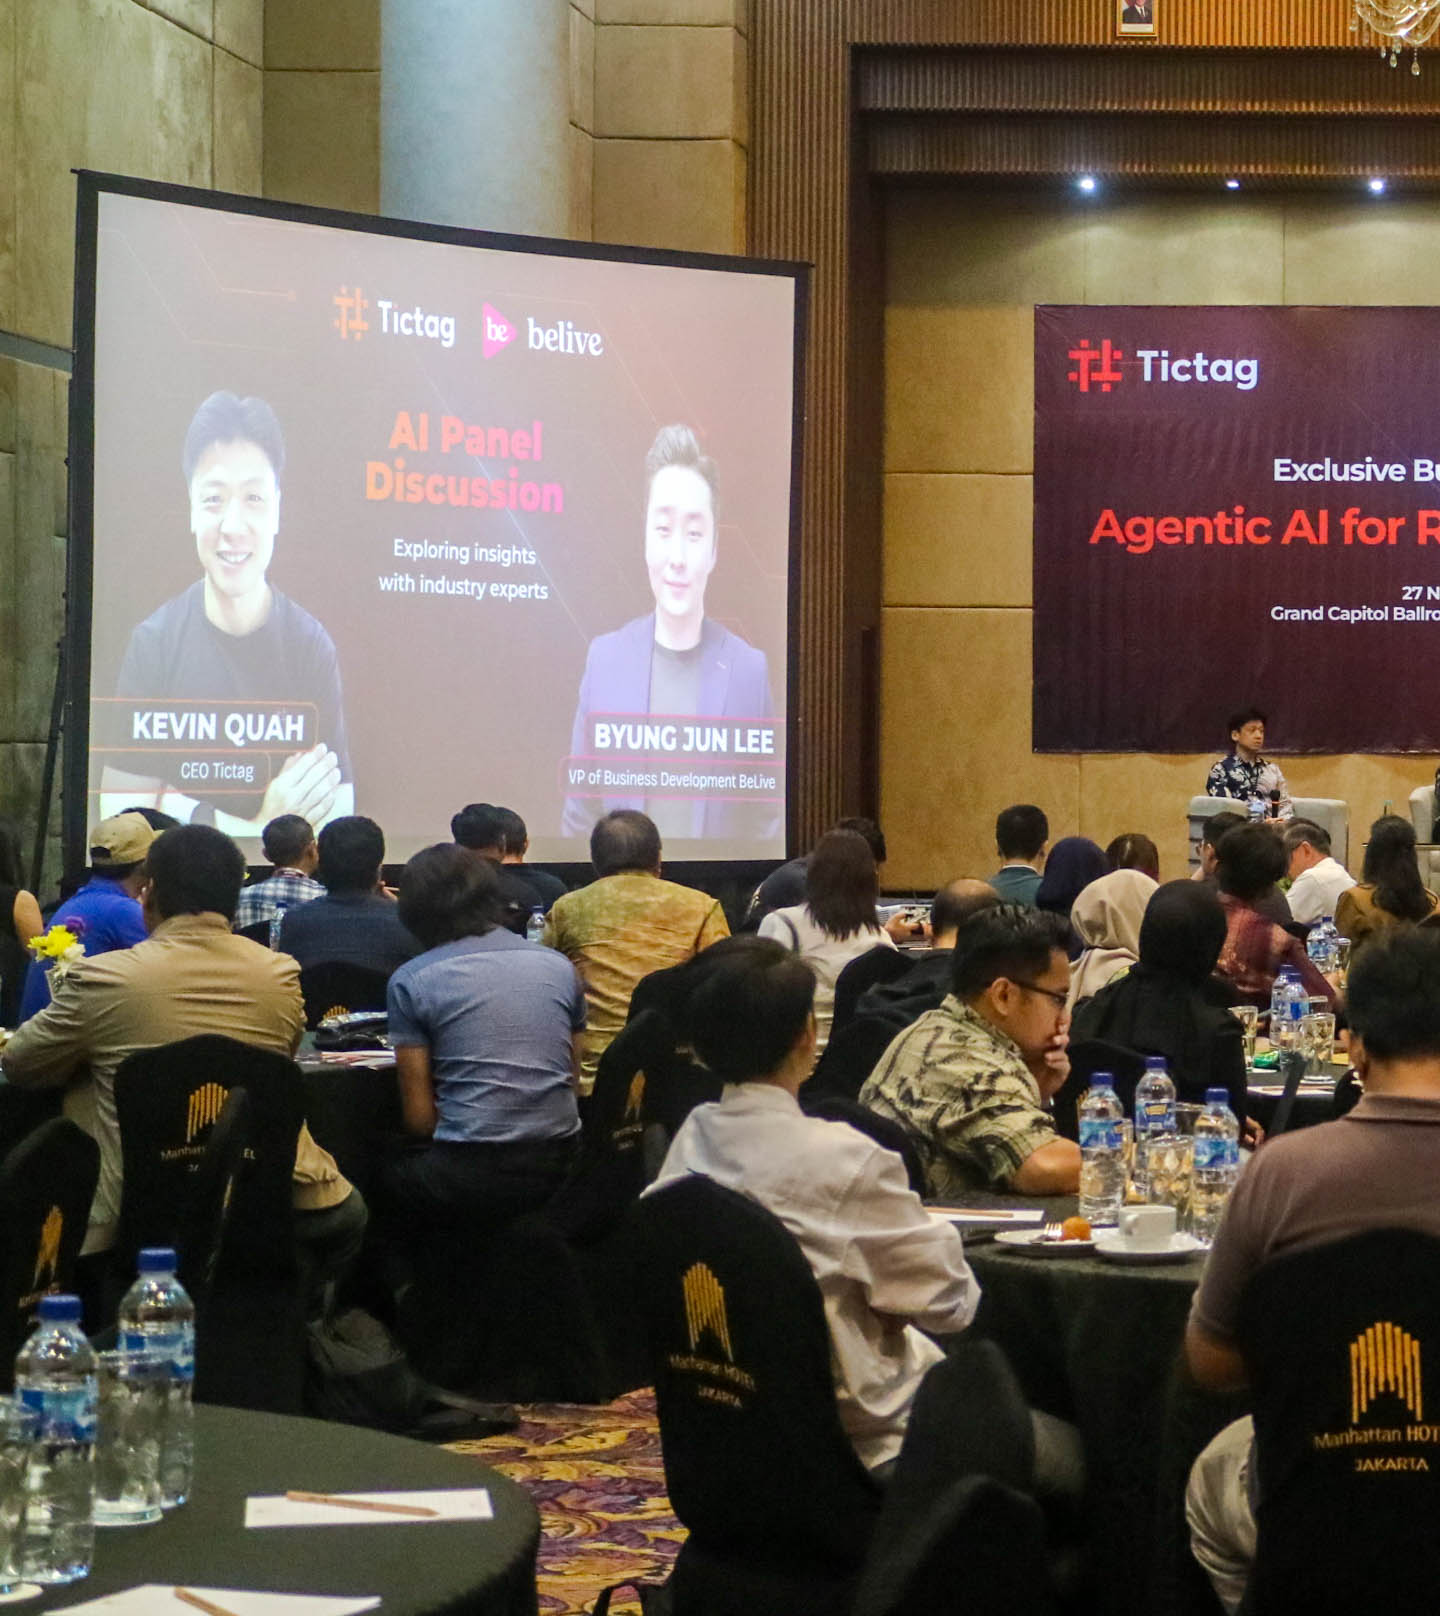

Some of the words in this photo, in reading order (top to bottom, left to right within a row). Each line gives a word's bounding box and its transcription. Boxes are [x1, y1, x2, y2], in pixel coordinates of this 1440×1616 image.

[378, 300, 456, 348] Tictag
[486, 316, 509, 342] be
[527, 317, 603, 356] belive
[1136, 350, 1258, 390] Tictag
[388, 411, 429, 451] AI
[441, 416, 543, 461] Panel
[366, 456, 563, 513] Discussion
[1273, 457, 1406, 482] Exclusive
[1089, 505, 1272, 554] Agentic
[1281, 509, 1327, 545] AI
[1340, 507, 1405, 545] for
[393, 538, 469, 564] Exploring
[474, 543, 536, 567] insights
[378, 572, 415, 592] with
[419, 574, 486, 600] industry
[490, 579, 548, 602] experts
[1402, 586, 1423, 600] 27
[1271, 605, 1323, 621] Grand
[1328, 605, 1388, 624] Capitol
[133, 711, 217, 740] KEVIN
[224, 712, 304, 747] QUAH
[595, 723, 677, 751] BYUNG
[683, 726, 728, 752] JUN
[734, 729, 774, 754] LEE
[181, 762, 209, 779] CEO
[213, 762, 254, 783] Tictag
[568, 769, 585, 784] VP
[588, 770, 601, 785] of
[604, 770, 657, 786] Business
[661, 772, 736, 789] Development
[739, 775, 776, 789] BeLive
[1313, 1428, 1401, 1449] Manhattan
[1355, 1457, 1430, 1472] JAKARTA
